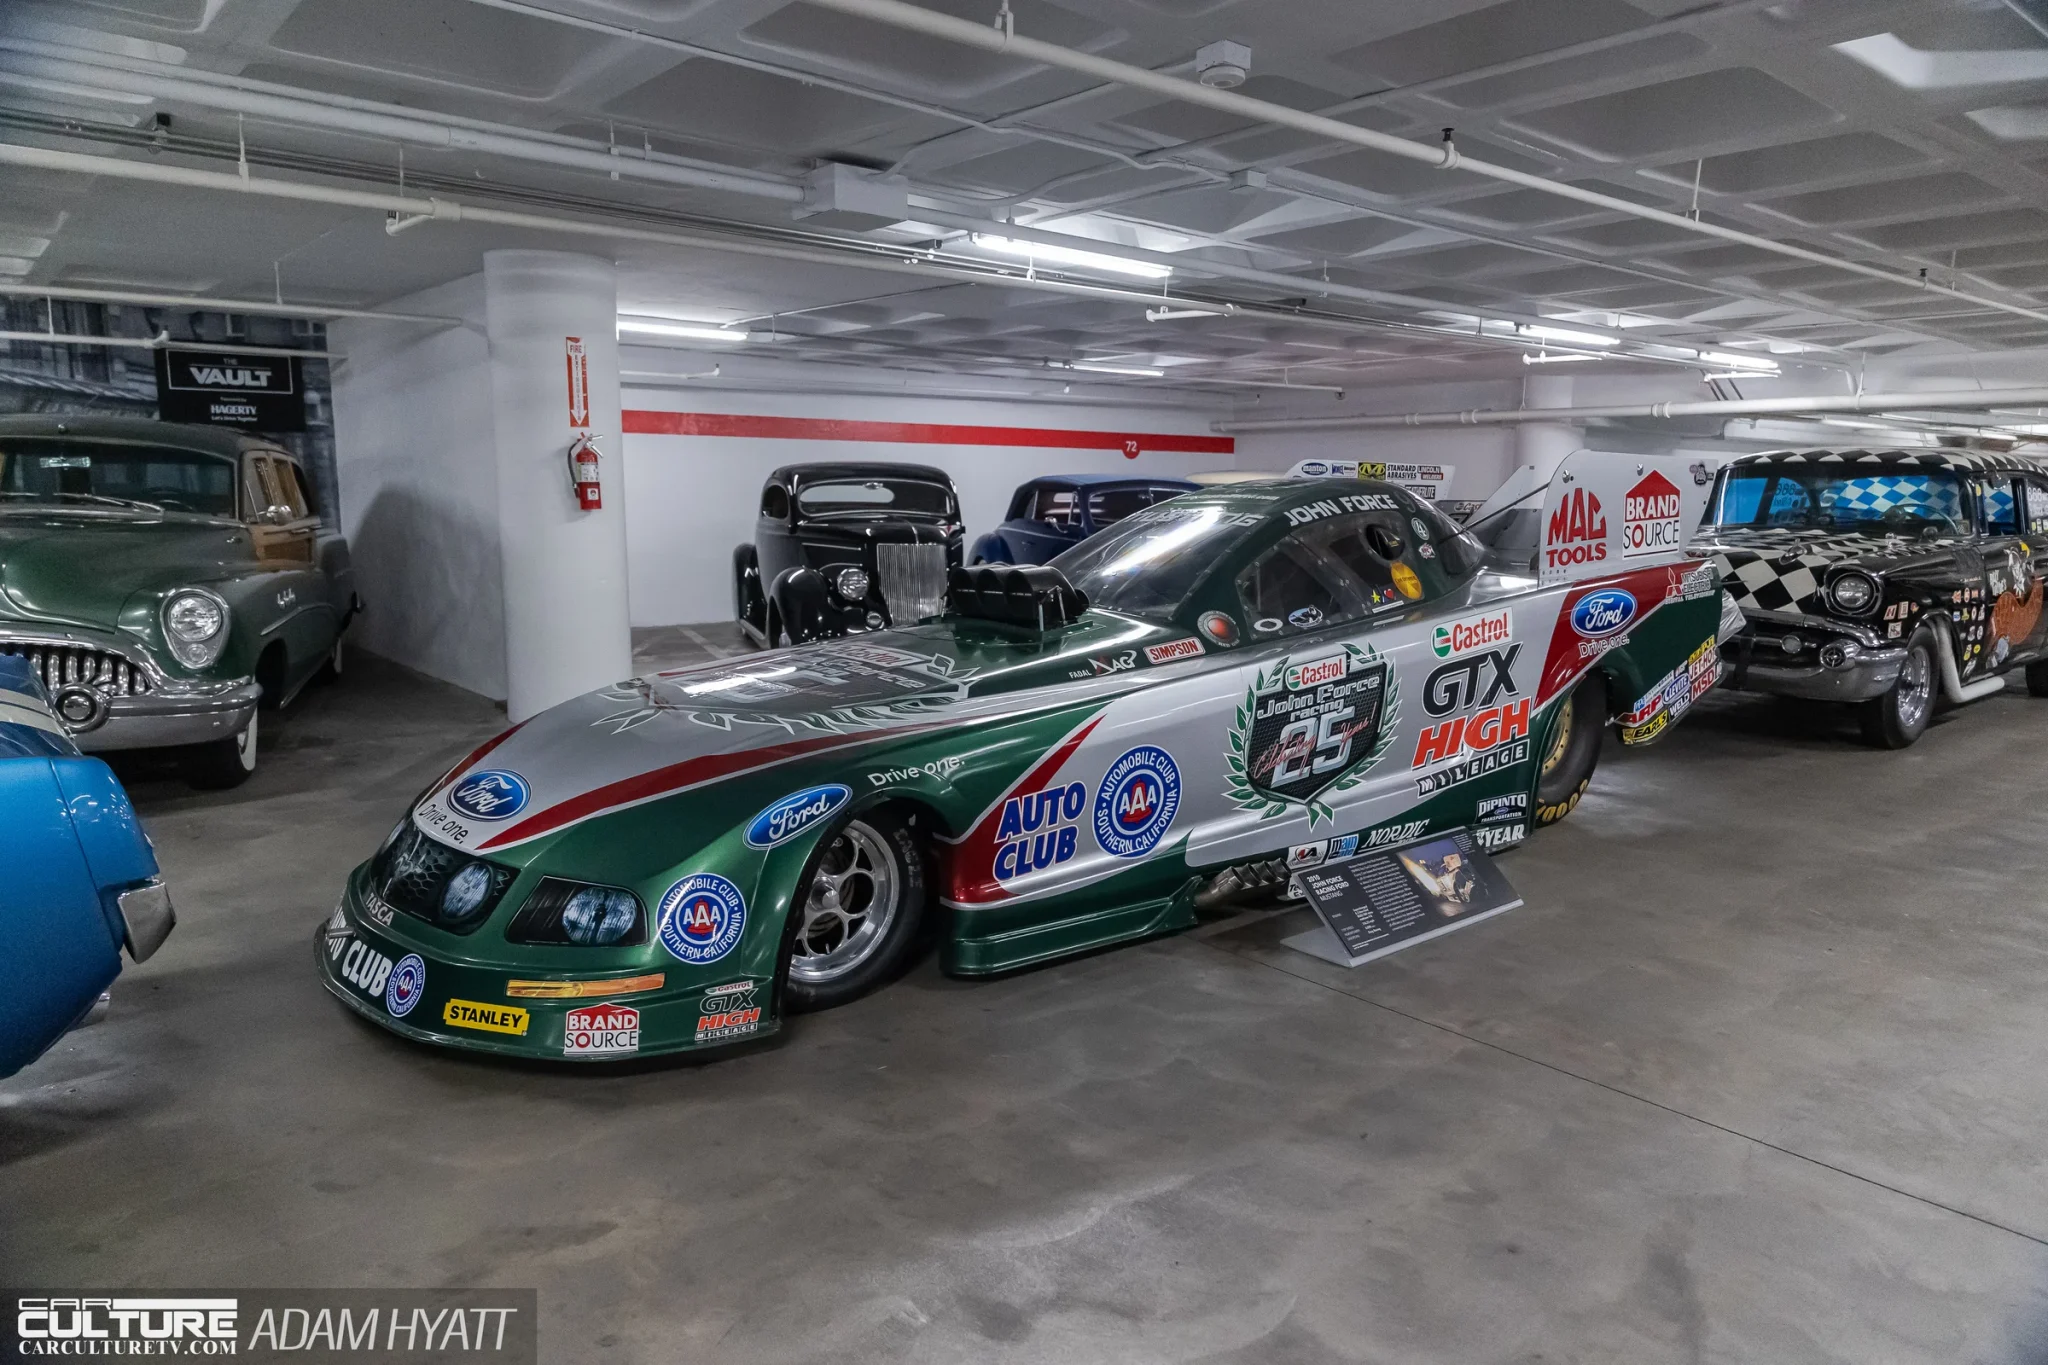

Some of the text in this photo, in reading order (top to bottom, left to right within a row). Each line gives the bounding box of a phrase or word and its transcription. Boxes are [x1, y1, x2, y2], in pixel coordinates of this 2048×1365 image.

[569, 345, 582, 353] FIRE
[189, 367, 272, 387] VAULT
[211, 404, 257, 415] HAGERTY
[1125, 440, 1137, 452] 72
[1387, 464, 1417, 472] STANDARD
[1283, 495, 1400, 526] JOHN FORCE
[1547, 487, 1607, 546] MAC
[1626, 494, 1679, 520] BRAND
[1623, 520, 1679, 549] SOURCE
[1546, 543, 1607, 568] TOOLS
[1586, 597, 1624, 629] Ford
[1452, 612, 1510, 652] Castrol
[1149, 640, 1199, 660] SIMPSON
[1578, 633, 1630, 658] Drive one.
[1069, 669, 1093, 679] FADAL
[1301, 659, 1344, 685] Castrol
[1422, 641, 1523, 718] GTX
[1692, 668, 1715, 699] MSD
[1257, 676, 1380, 719] John Force
[1664, 677, 1688, 702] CLEVITE
[1290, 698, 1345, 722] racing
[1626, 694, 1662, 724] ARP
[1670, 692, 1690, 716] WELD
[1411, 696, 1532, 770] HIGH
[1253, 732, 1316, 779] Celebrating
[1270, 705, 1356, 788] 25
[867, 756, 965, 787] Drive one.
[1101, 751, 1176, 801] AUTOMOBILE CLUB
[1418, 743, 1527, 795] MILEAGE
[457, 775, 513, 812] Ford
[1118, 785, 1157, 815] AAA
[418, 804, 469, 844] Drive one.
[768, 793, 830, 840] Ford
[994, 780, 1087, 844] AUTO
[1097, 788, 1177, 853] SOUTHERN CALIFORNIA
[1481, 811, 1522, 822] TRANSPORTATION
[1332, 836, 1358, 852] main
[1361, 818, 1430, 848] NORDIC
[992, 825, 1079, 882] CLUB
[1307, 874, 1320, 882] 2010
[1312, 875, 1343, 889] JOHN FORCE
[1315, 881, 1349, 895] RACING FORD
[663, 877, 739, 911] AUTOMOBILE CLUB
[1320, 890, 1343, 901] MUSTANG
[365, 892, 394, 926] TASCA
[682, 905, 721, 927] AAA
[662, 912, 742, 959] SOUTHERN CALIFORNIA
[342, 940, 393, 997] CLUB
[398, 975, 413, 992] AAA
[717, 981, 751, 992] Castrol
[700, 988, 759, 1014] GTX
[450, 1005, 523, 1029] STANLEY
[568, 1013, 637, 1031] BRAND
[697, 1007, 761, 1031] HIGH
[565, 1030, 637, 1048] SOURCE
[696, 1023, 756, 1039] MILEAGE
